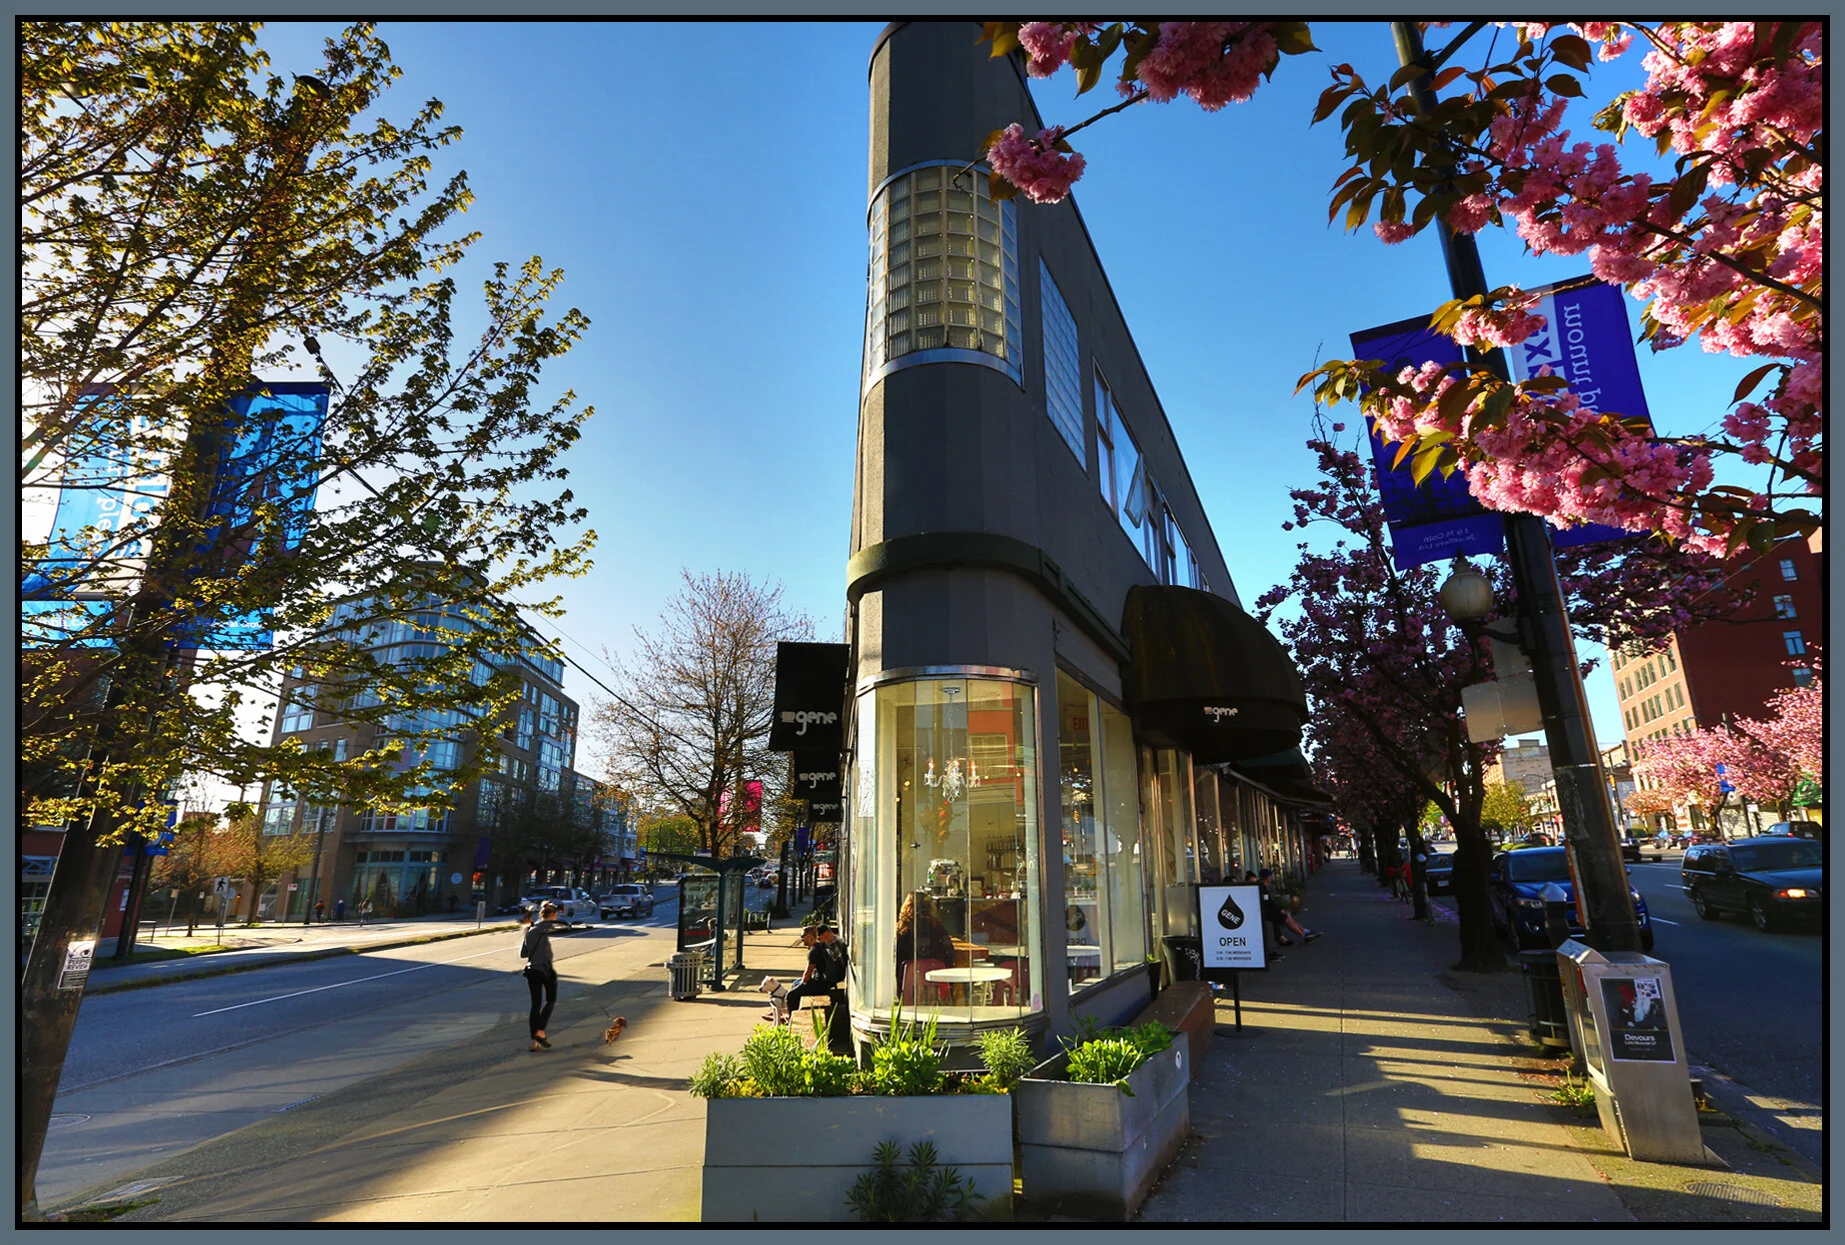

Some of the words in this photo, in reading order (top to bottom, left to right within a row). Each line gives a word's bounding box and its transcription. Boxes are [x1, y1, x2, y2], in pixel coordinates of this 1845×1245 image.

[795, 710, 837, 735] gene
[1212, 706, 1239, 723] gene
[808, 771, 837, 789] gene
[1221, 909, 1241, 924] GENE
[1219, 937, 1246, 946] OPEN
[1624, 1033, 1655, 1041] Devours
